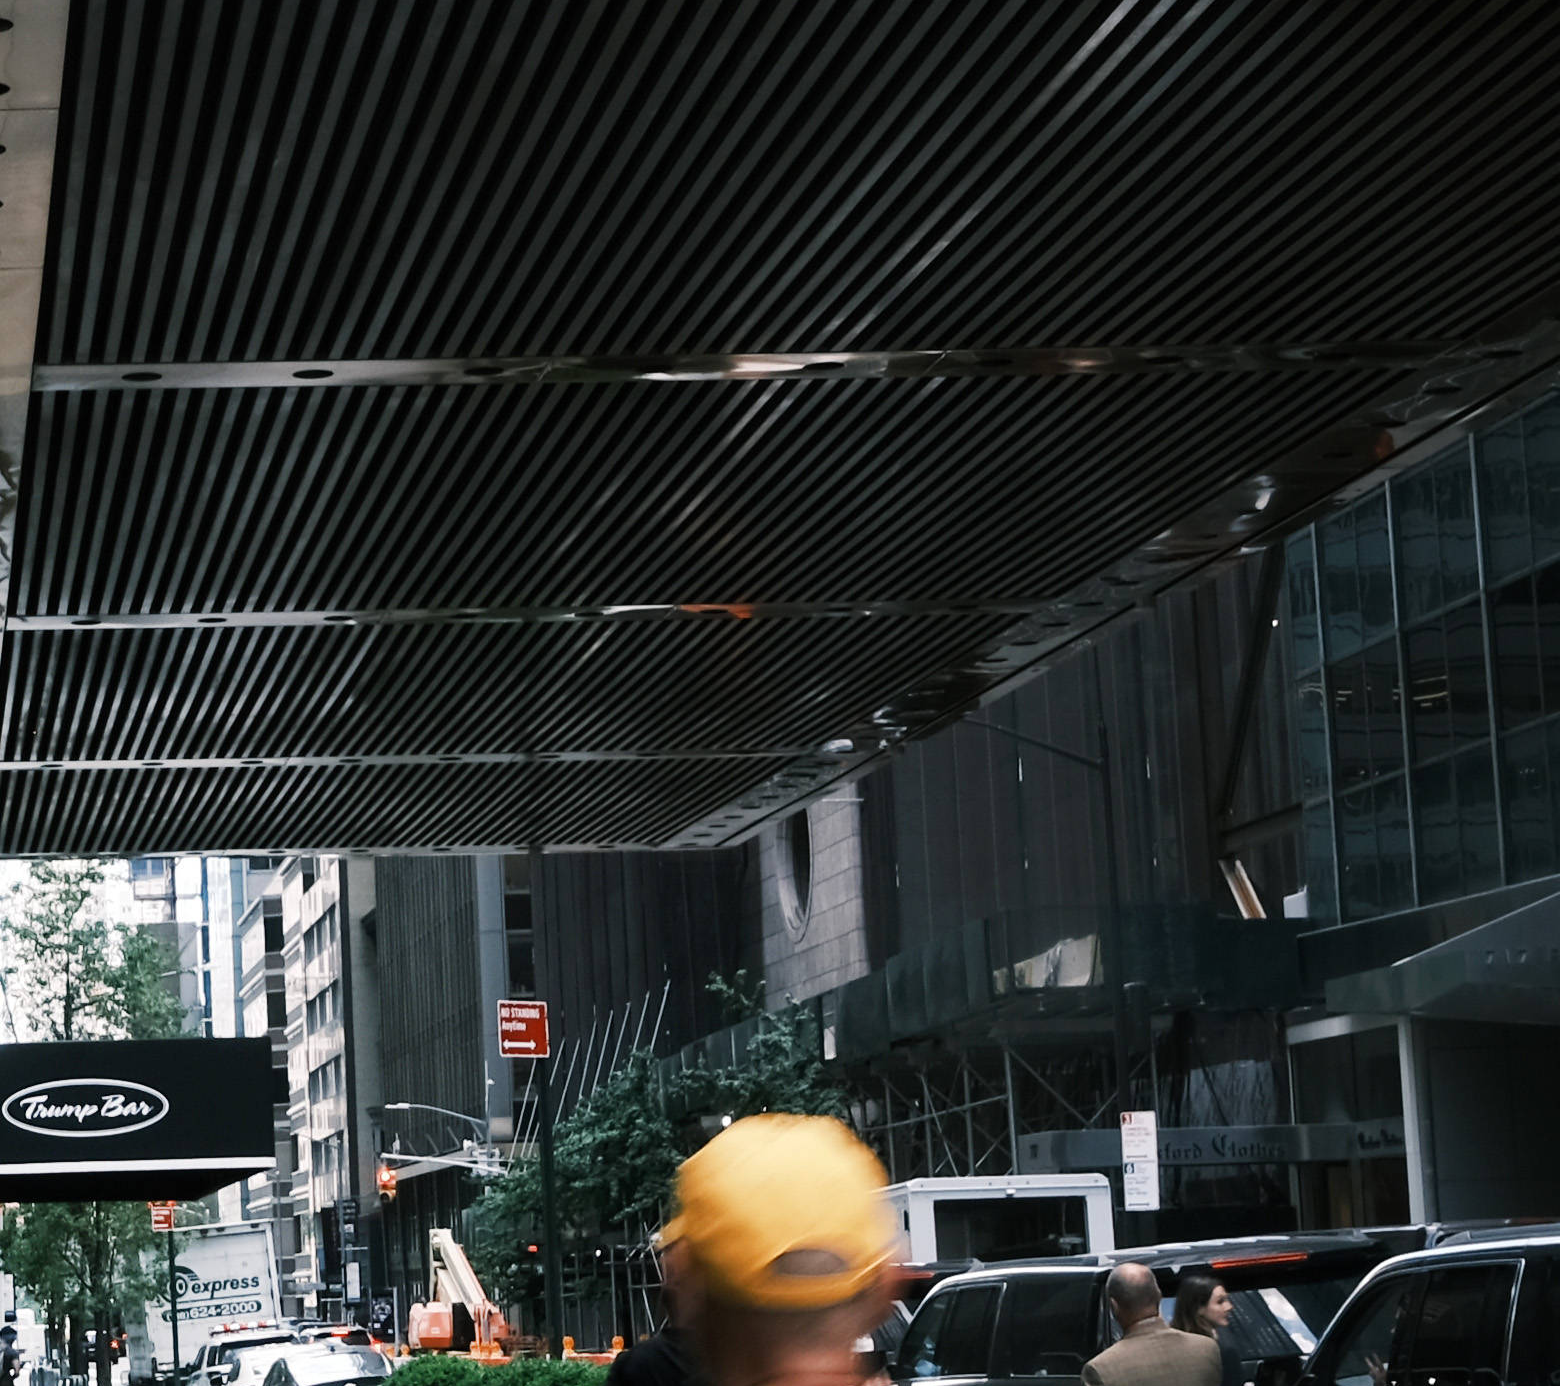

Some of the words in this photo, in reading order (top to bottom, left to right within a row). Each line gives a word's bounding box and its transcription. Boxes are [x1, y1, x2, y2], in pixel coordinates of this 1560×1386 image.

[19, 1094, 99, 1124] Trump
[101, 1094, 154, 1118] Bar
[191, 1276, 260, 1299] express
